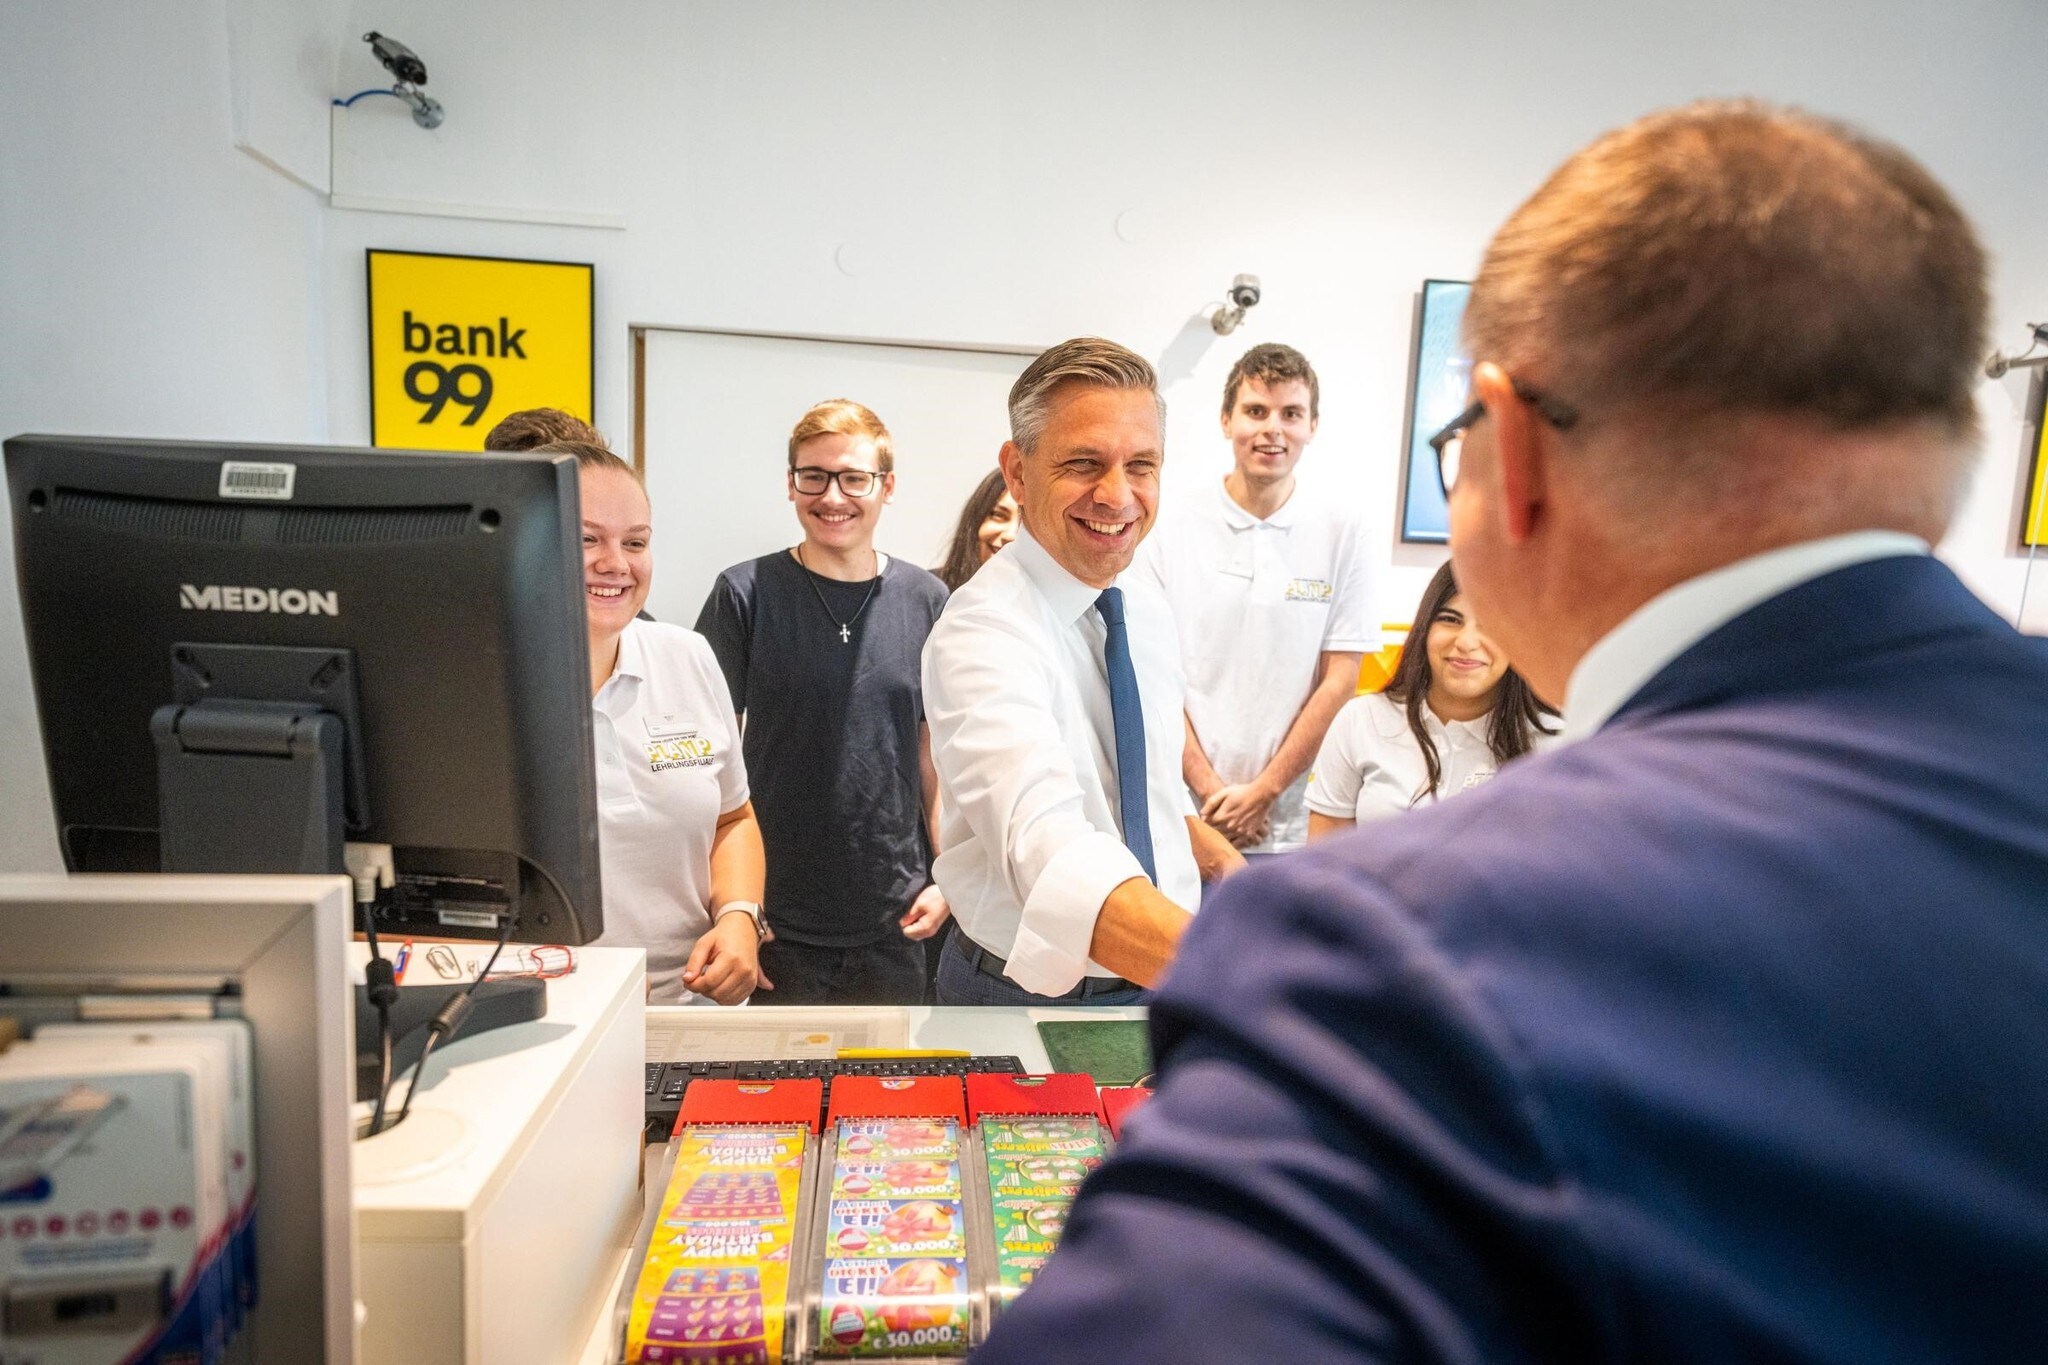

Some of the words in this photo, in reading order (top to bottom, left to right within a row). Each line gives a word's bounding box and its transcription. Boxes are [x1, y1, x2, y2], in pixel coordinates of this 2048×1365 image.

[403, 310, 527, 359] bank
[403, 360, 493, 427] 99
[179, 583, 339, 617] MEDION
[680, 1244, 759, 1259] HAPPY
